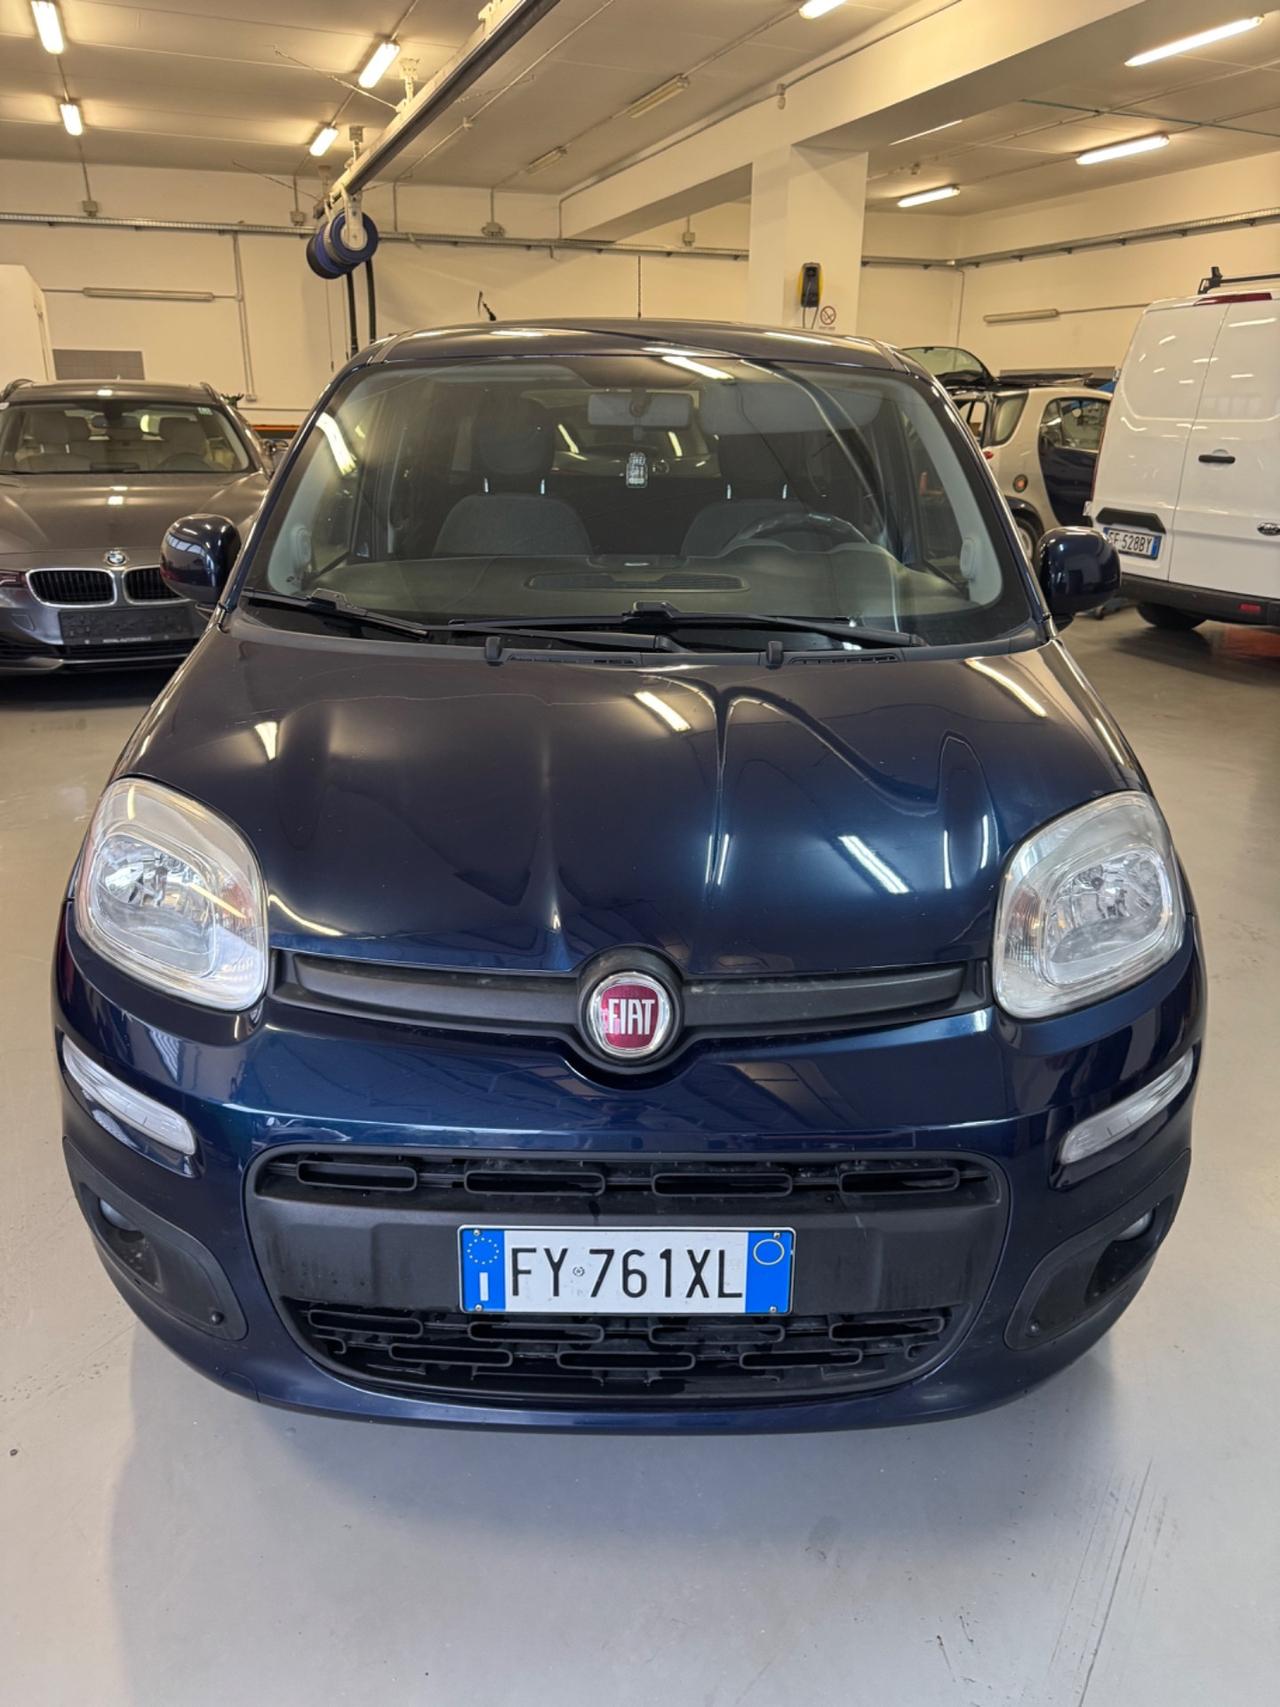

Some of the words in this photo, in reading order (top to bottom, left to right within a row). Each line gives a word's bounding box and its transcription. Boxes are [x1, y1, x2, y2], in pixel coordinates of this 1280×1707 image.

[1121, 533, 1152, 553] 528BY
[608, 998, 656, 1035] FIAT
[479, 1271, 489, 1301] I
[511, 1247, 569, 1298] FY
[589, 1248, 743, 1299] 761XL
